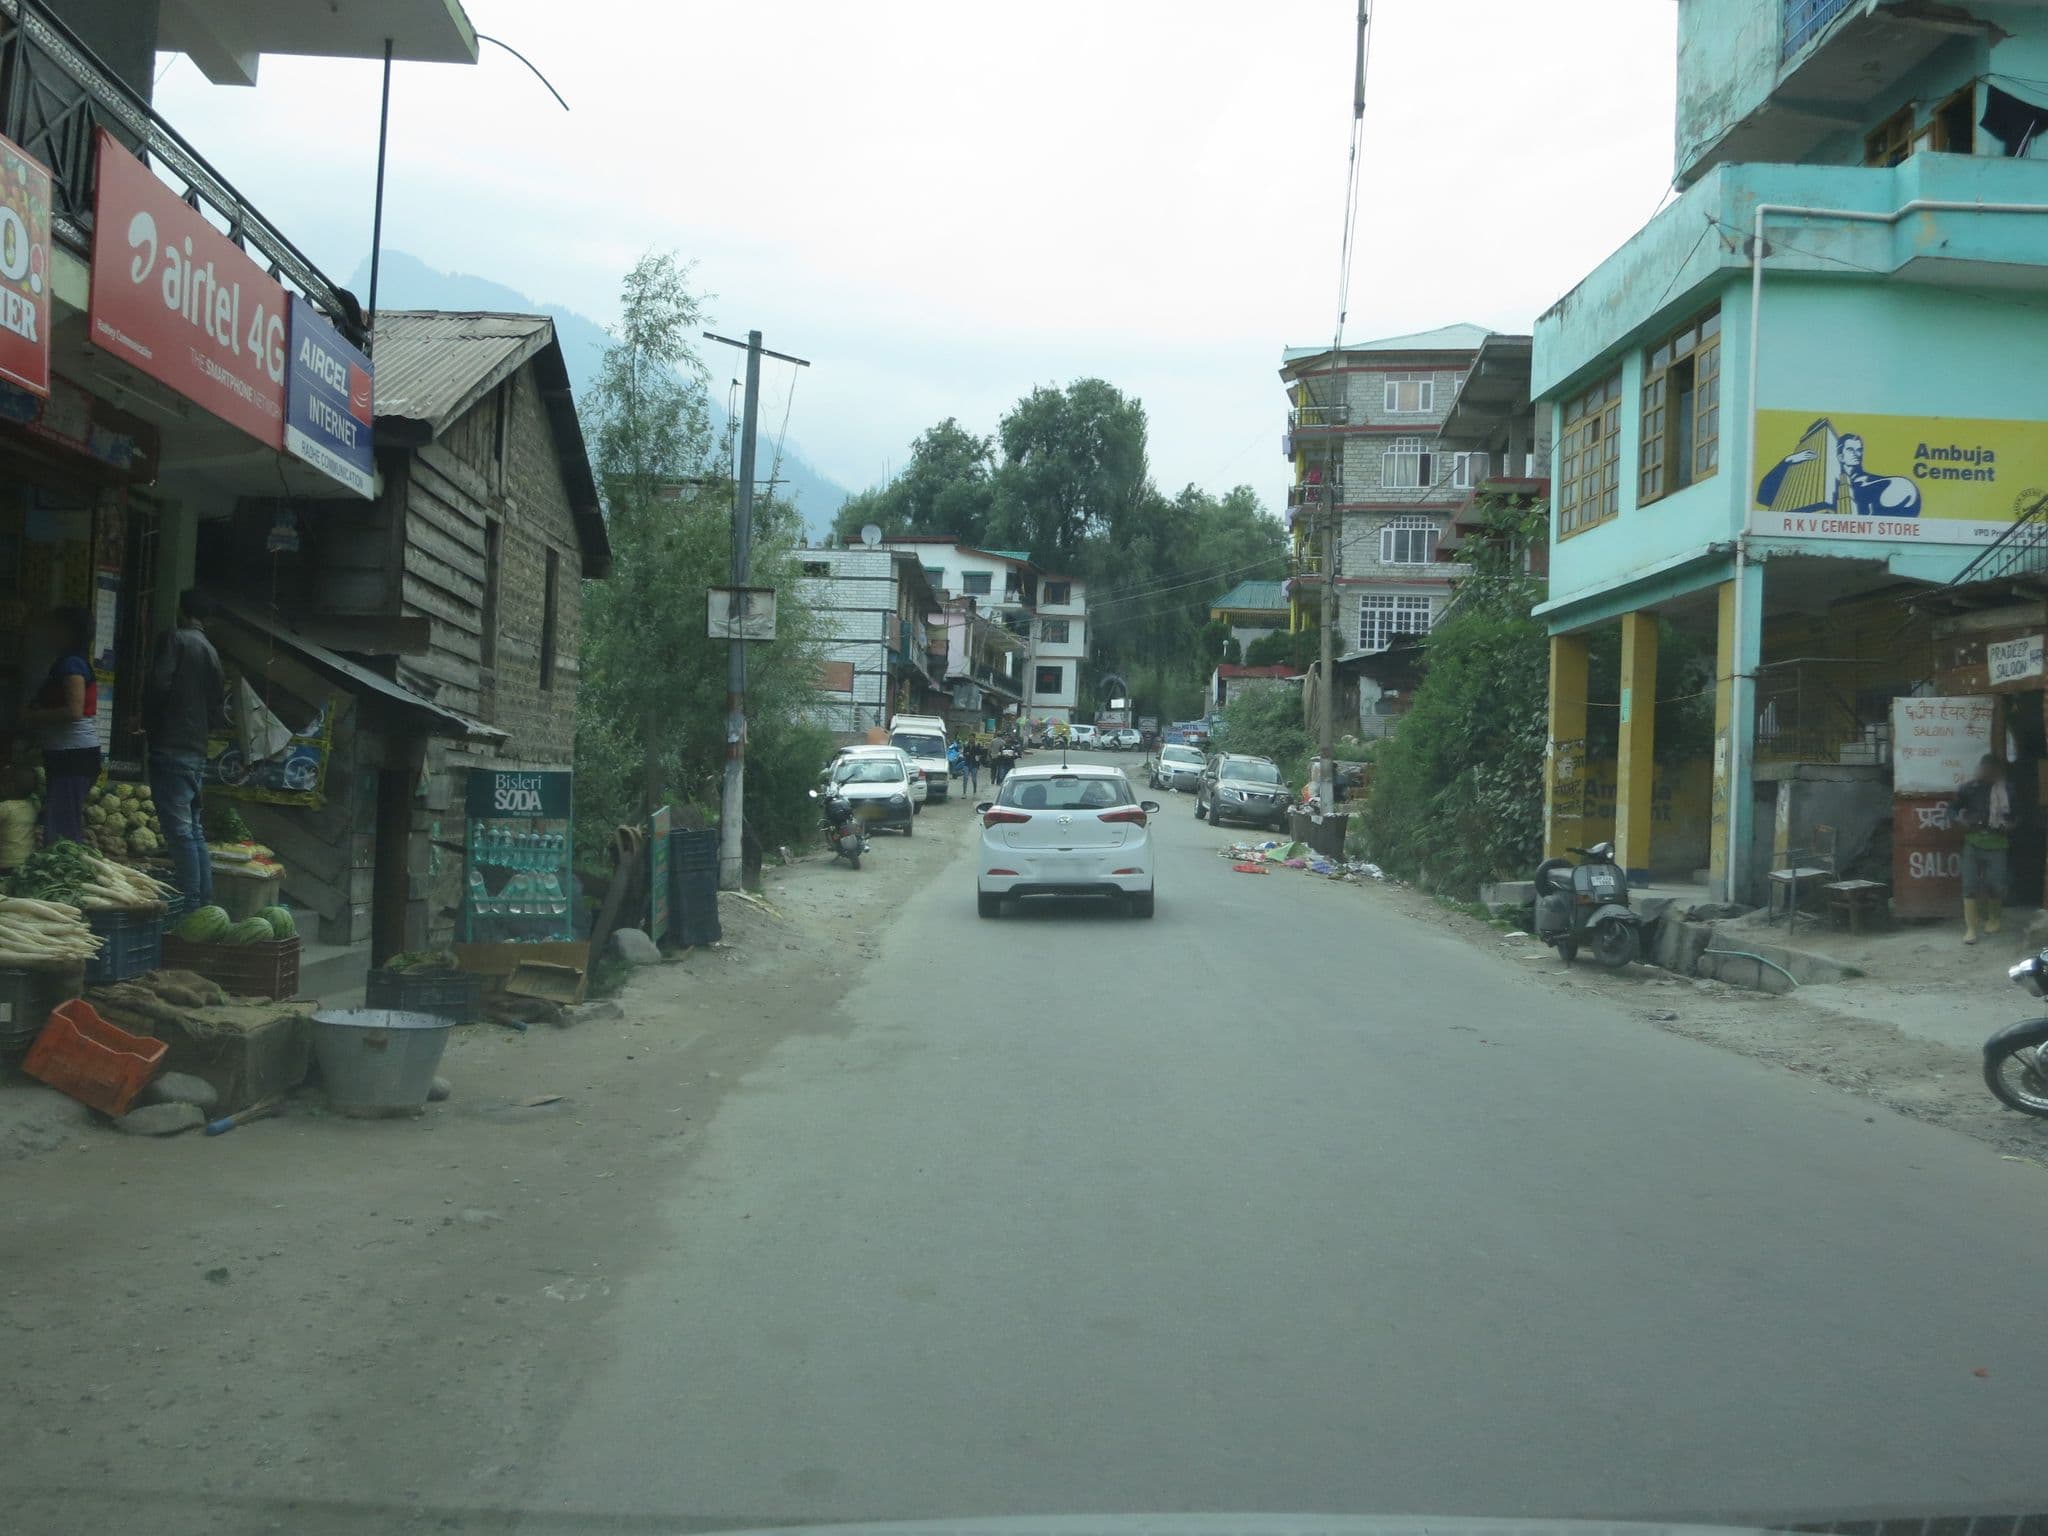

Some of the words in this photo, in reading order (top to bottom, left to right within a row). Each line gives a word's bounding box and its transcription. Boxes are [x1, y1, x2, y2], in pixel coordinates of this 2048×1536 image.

[162, 236, 240, 355] airtel
[247, 304, 285, 387] 4G
[299, 336, 349, 397] AIRCEL
[206, 357, 254, 403] SMARTPHONE
[309, 394, 357, 449] INTERNET
[1913, 443, 1995, 466] Ambuja
[320, 453, 364, 489] COMMUNICATION
[1913, 462, 1995, 482] Cement
[1783, 518, 1792, 531] R
[1796, 519, 1804, 532] K
[1809, 520, 1817, 532] V
[1821, 519, 1873, 535] CEMENT
[1878, 521, 1920, 537] STORE
[1996, 660, 2027, 679] SALOON
[495, 773, 542, 790] Bisleri
[494, 789, 543, 811] SODA
